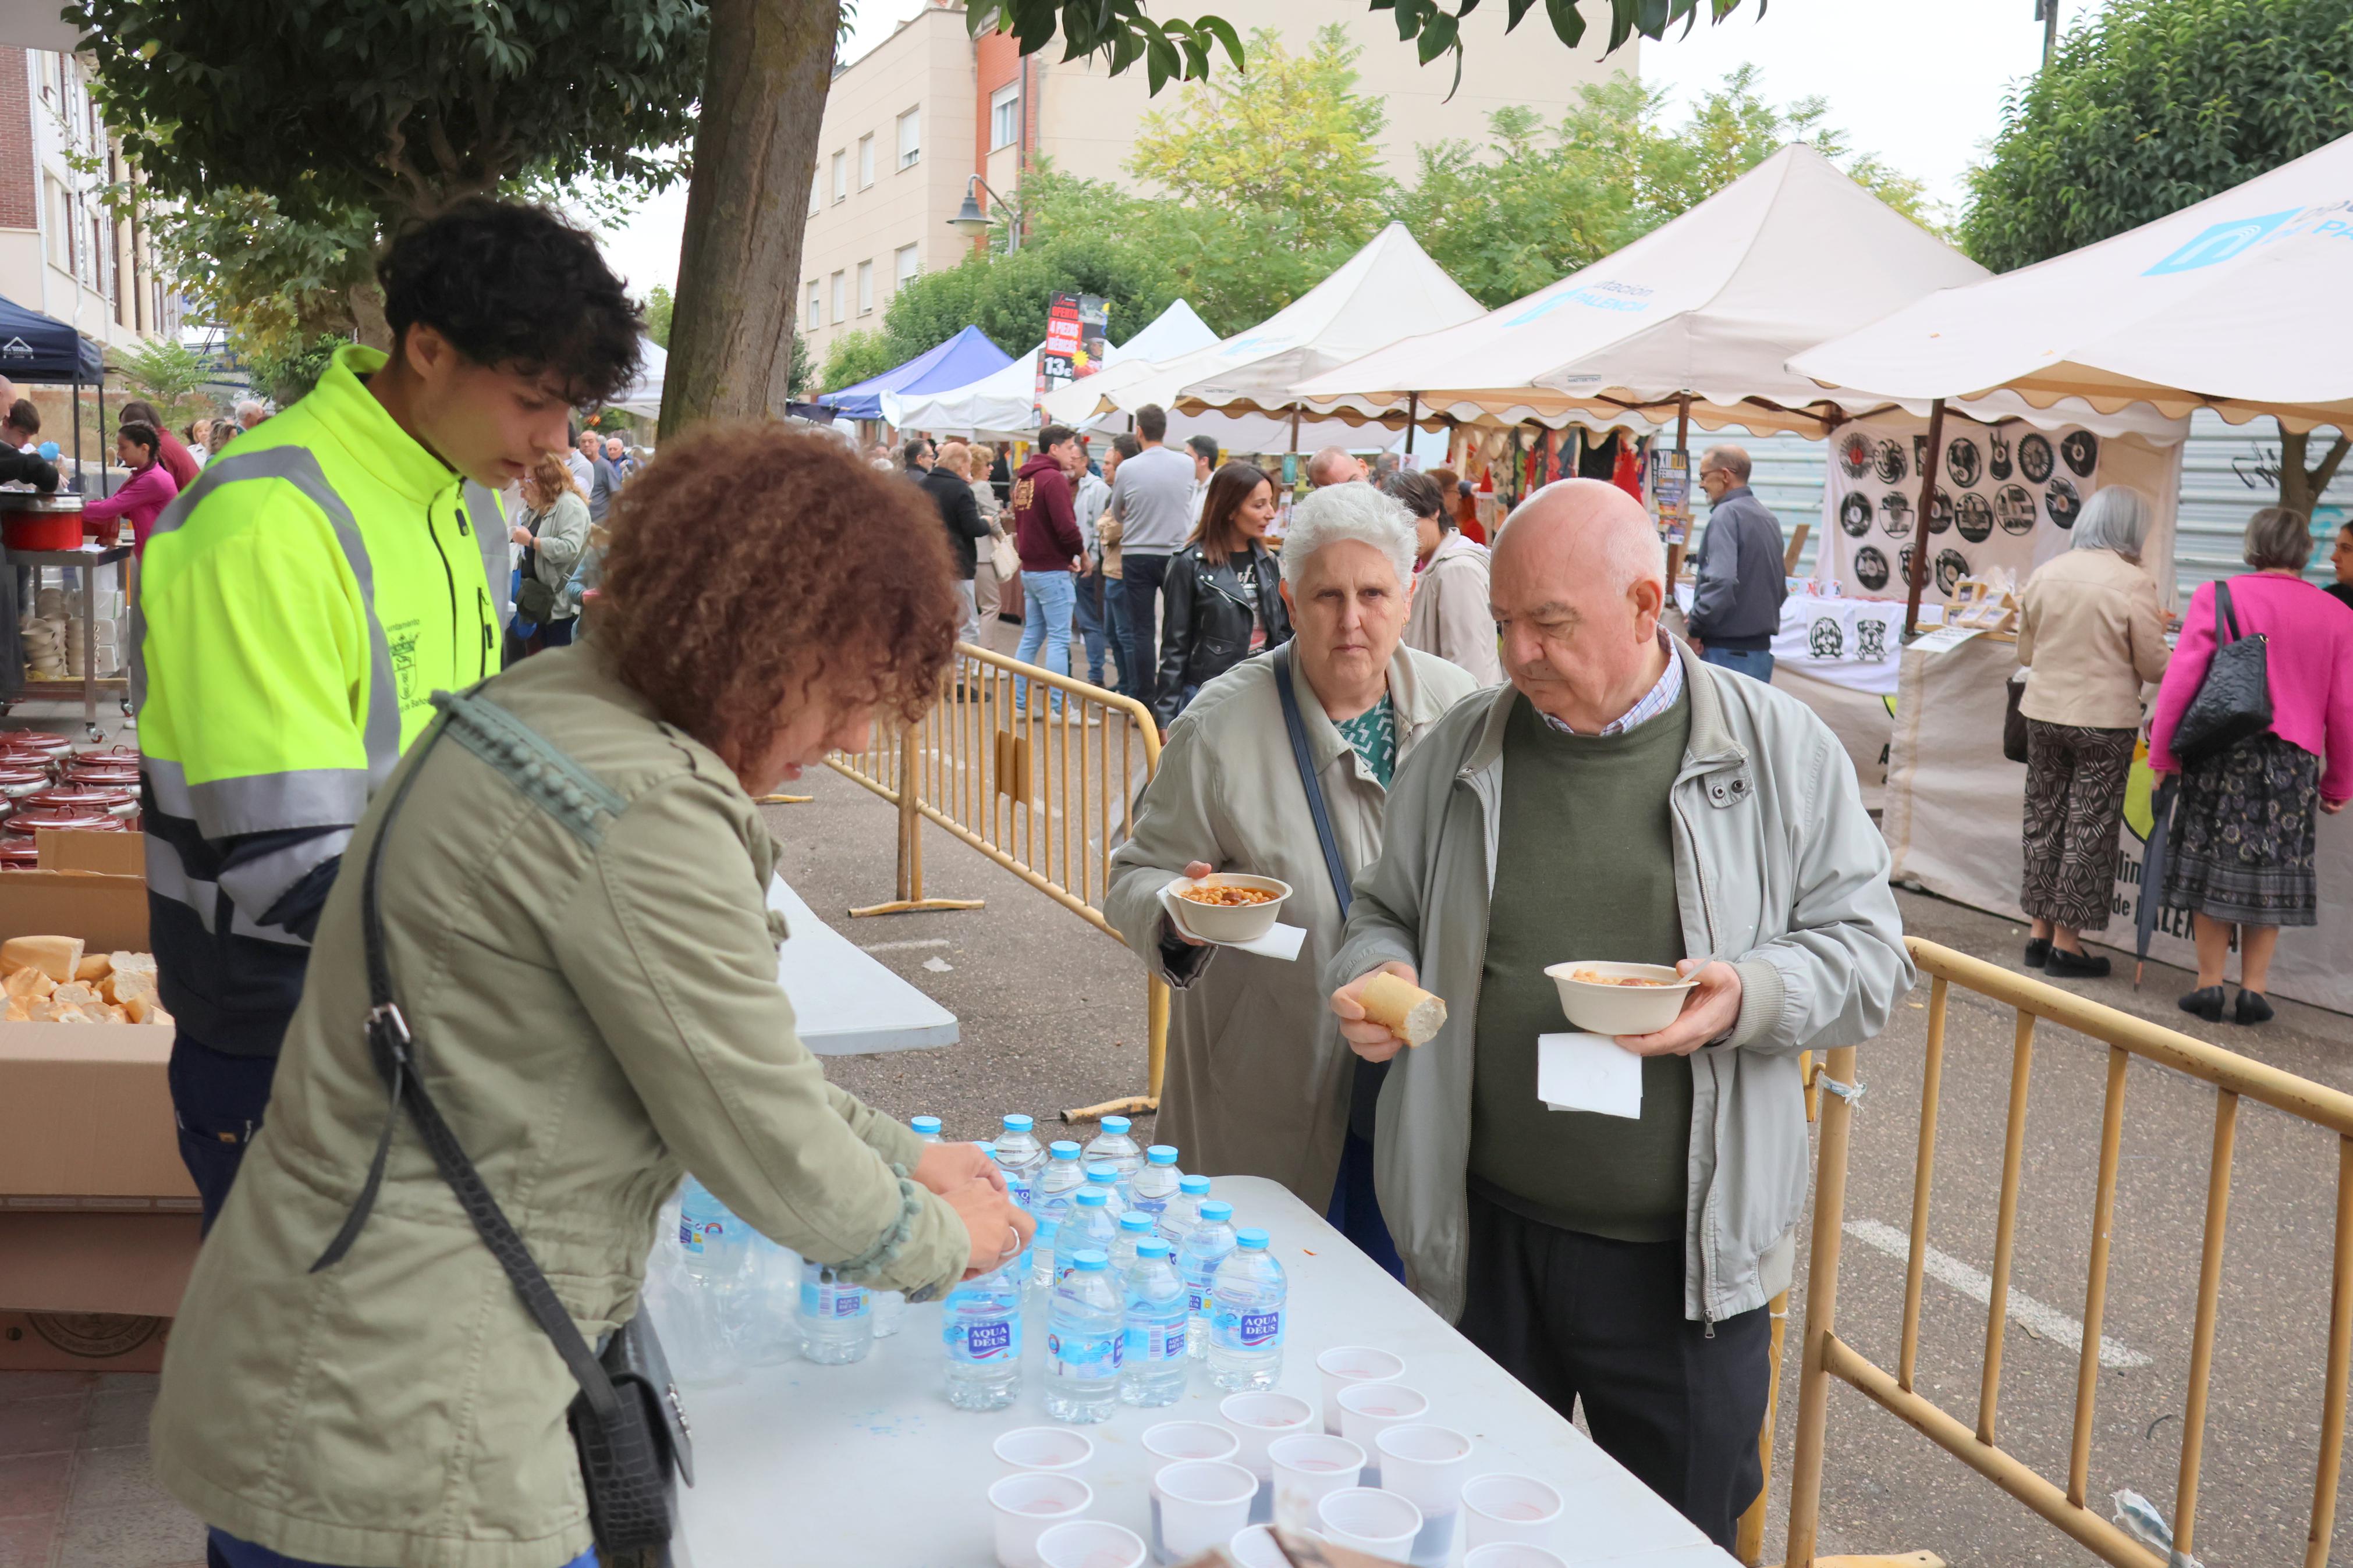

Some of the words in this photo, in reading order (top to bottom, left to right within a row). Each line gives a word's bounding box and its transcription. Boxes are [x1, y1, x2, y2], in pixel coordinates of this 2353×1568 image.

[1245, 1315, 1277, 1327] AQUA
[971, 1327, 1007, 1338] AQUA
[1246, 1324, 1276, 1334] DEUS
[973, 1336, 1006, 1347] DEUS
